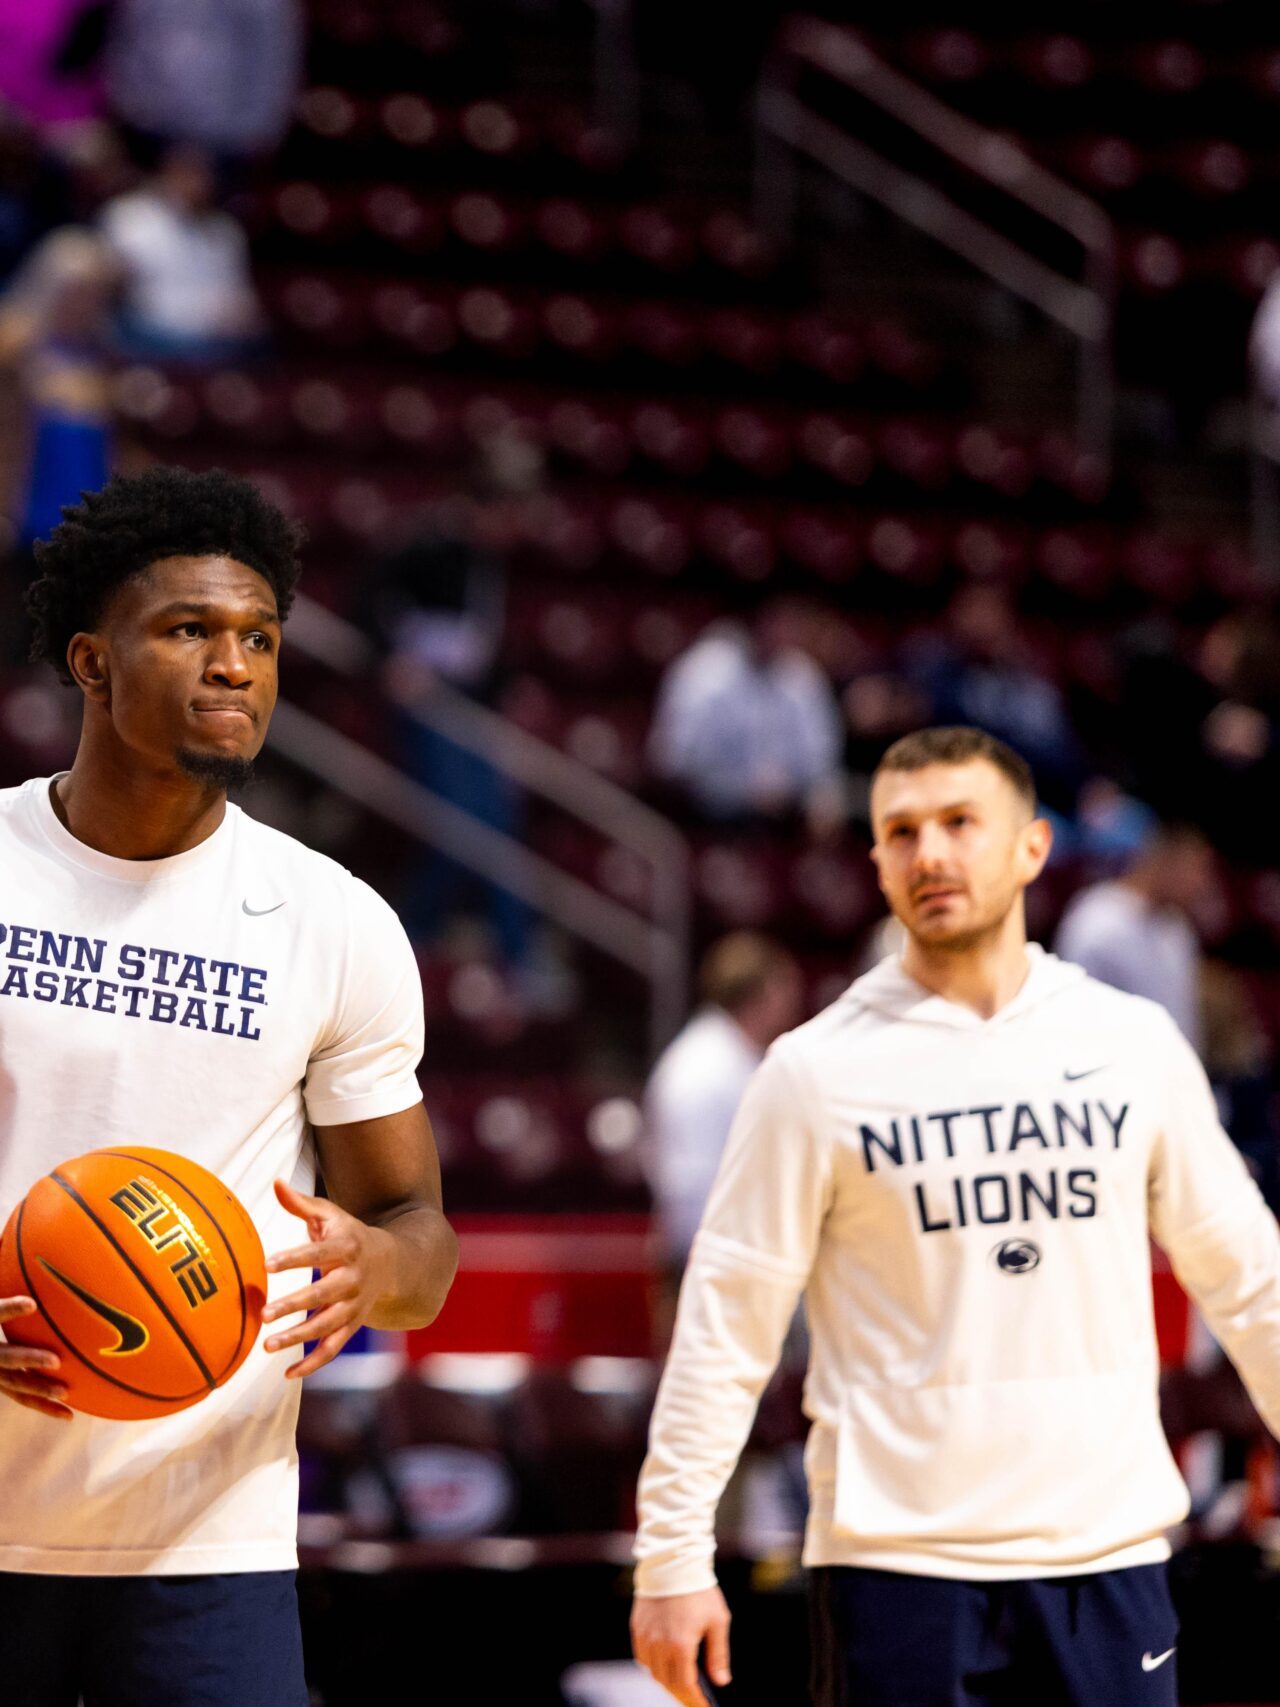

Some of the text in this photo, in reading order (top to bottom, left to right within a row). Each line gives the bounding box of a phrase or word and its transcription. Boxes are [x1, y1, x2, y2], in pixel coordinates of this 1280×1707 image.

[117, 943, 268, 1005] STATE
[858, 1100, 1130, 1173] NITTANY
[914, 1168, 1098, 1233] LIONS
[108, 1179, 219, 1311] ELITE
